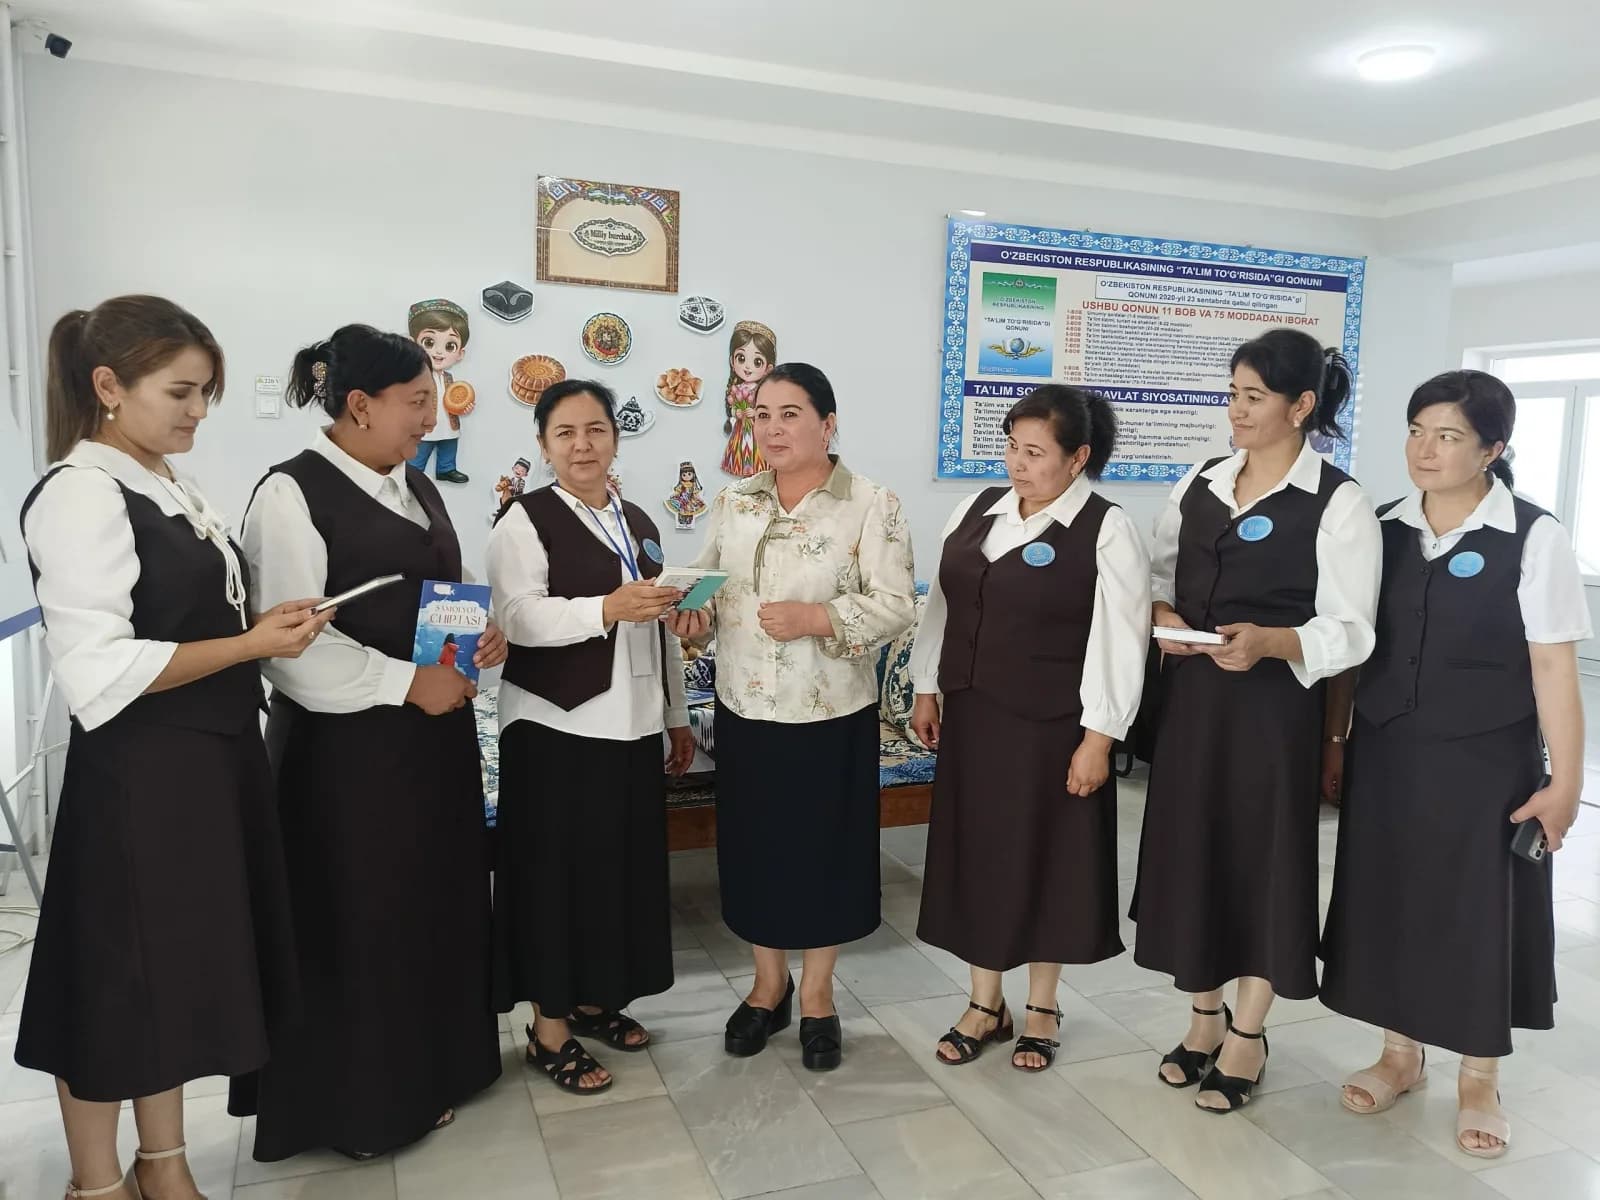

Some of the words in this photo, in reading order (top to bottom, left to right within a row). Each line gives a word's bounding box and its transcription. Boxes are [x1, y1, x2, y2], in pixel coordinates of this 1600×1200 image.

[590, 230, 606, 240] Milliy
[608, 231, 632, 240] burchak
[1000, 250, 1072, 264] O'ZBEKISTON
[1074, 258, 1174, 273] RESPUBLIKASINING
[1286, 277, 1322, 286] QONUNI
[1100, 280, 1150, 290] O'ZBEKISTON
[1153, 284, 1223, 296] RESPUBLIKASINING
[1128, 291, 1158, 299] QONUNI
[1159, 293, 1186, 302] 2020-yil
[1197, 296, 1230, 304] sentabrda
[1232, 299, 1250, 307] qabul
[1252, 300, 1278, 310] qilingan
[1082, 301, 1118, 311] USHBU
[1122, 304, 1159, 314] QONUN
[1175, 308, 1196, 317] BOB
[1214, 311, 1224, 319] 75
[1227, 312, 1282, 323] MODDADAN
[1285, 315, 1320, 326] IBORAT
[974, 385, 1013, 396] TA'LIM
[1094, 390, 1139, 401] DAVLAT
[1142, 392, 1218, 404] SIYOSATINING
[430, 613, 480, 625] CHIPTASI
